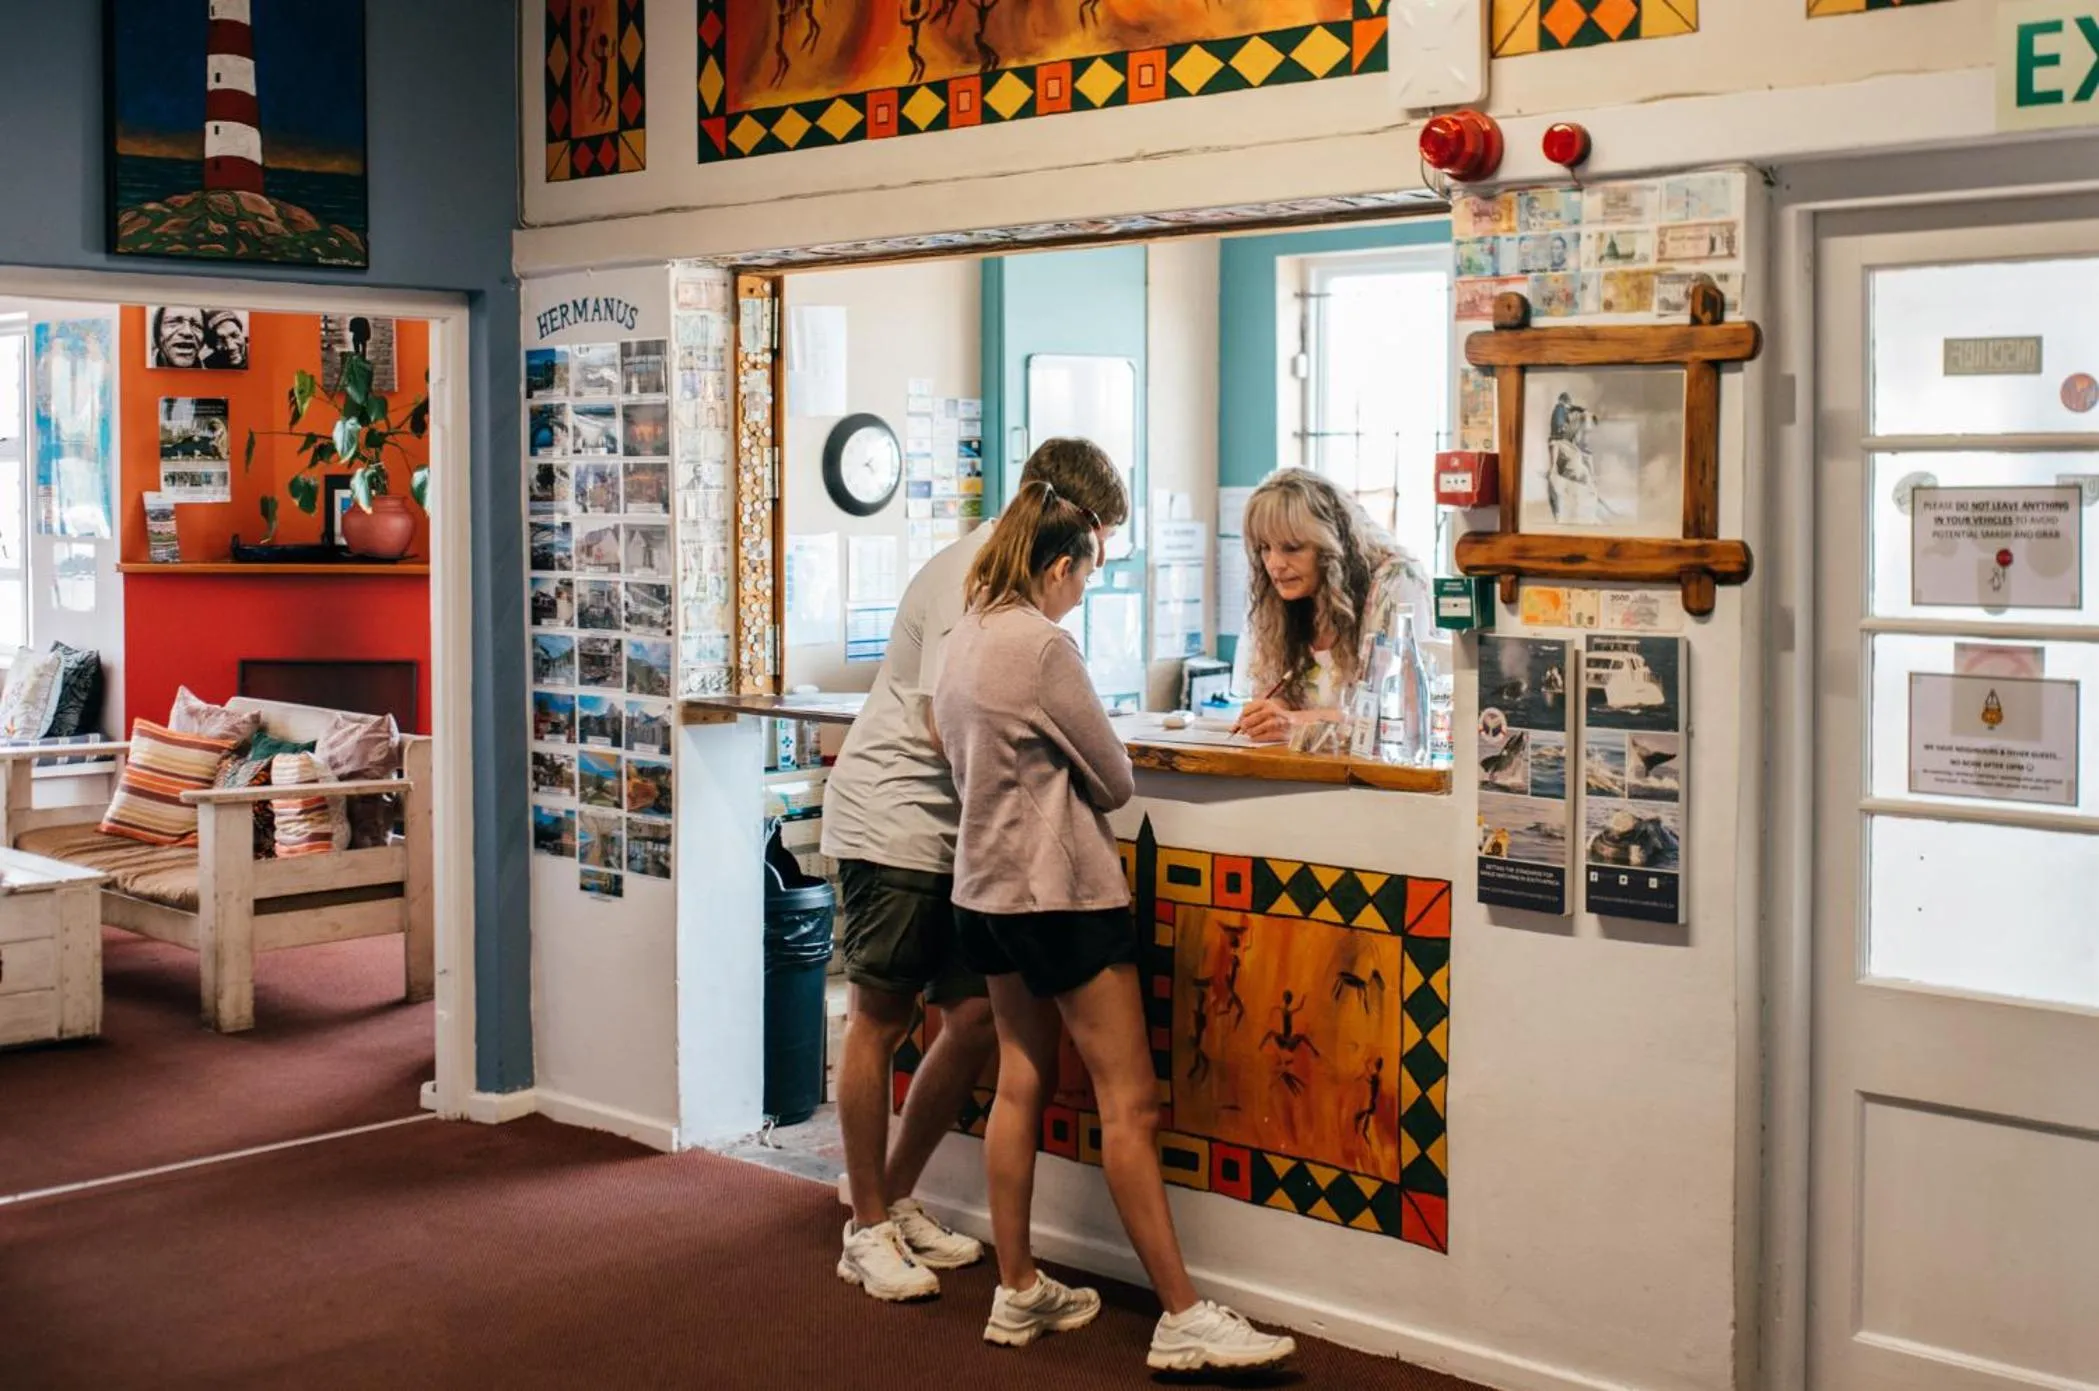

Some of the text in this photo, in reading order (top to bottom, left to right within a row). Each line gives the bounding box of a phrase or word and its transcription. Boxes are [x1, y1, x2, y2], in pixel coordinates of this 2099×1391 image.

[536, 297, 639, 340] HERMANUS
[1923, 502, 2069, 511] PLEASE DO NOT LEAVE ANYTHING
[1934, 516, 2059, 525] IN YOUR VEHICLES TO AVOID
[1932, 530, 1978, 539] POTENTIAL
[1981, 531, 2012, 539] SMASH
[2014, 531, 2034, 540] AND
